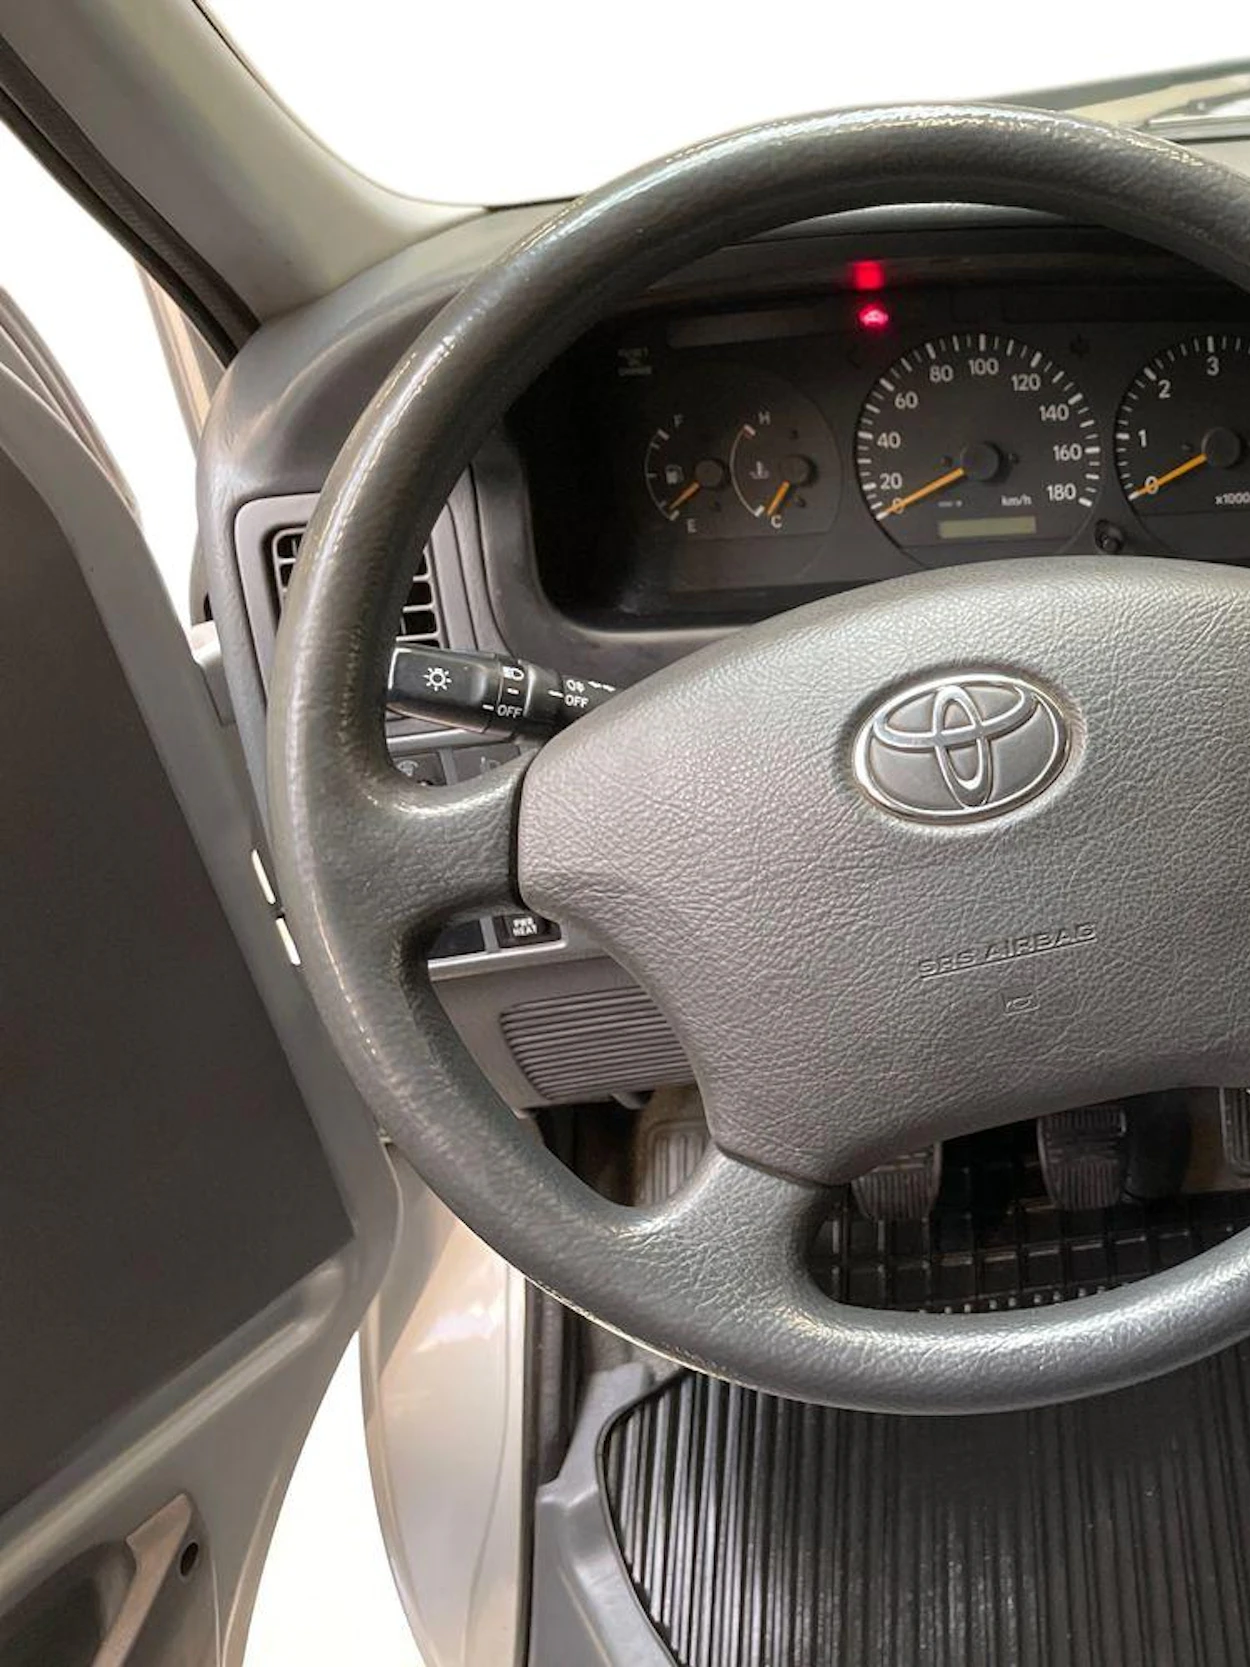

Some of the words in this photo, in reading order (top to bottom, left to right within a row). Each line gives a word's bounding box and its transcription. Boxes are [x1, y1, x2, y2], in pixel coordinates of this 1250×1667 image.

[929, 365, 953, 382] 80
[969, 358, 999, 375] 100
[1206, 356, 1220, 376] 3
[1011, 373, 1041, 391] 120
[1158, 380, 1171, 398] 2
[894, 391, 918, 409] 60
[758, 411, 771, 425] H
[1039, 404, 1070, 421] 140
[877, 432, 901, 448] 40
[1138, 429, 1147, 447] 1
[1053, 443, 1082, 461] 160
[880, 473, 902, 489] 20
[1144, 476, 1159, 494] 0
[1002, 495, 1032, 506] km/h
[1047, 484, 1076, 500] 180
[686, 518, 697, 533] E
[771, 514, 783, 529] C
[564, 696, 589, 708] OFF
[497, 704, 523, 718] OFF
[985, 922, 1097, 962] AIRBAG
